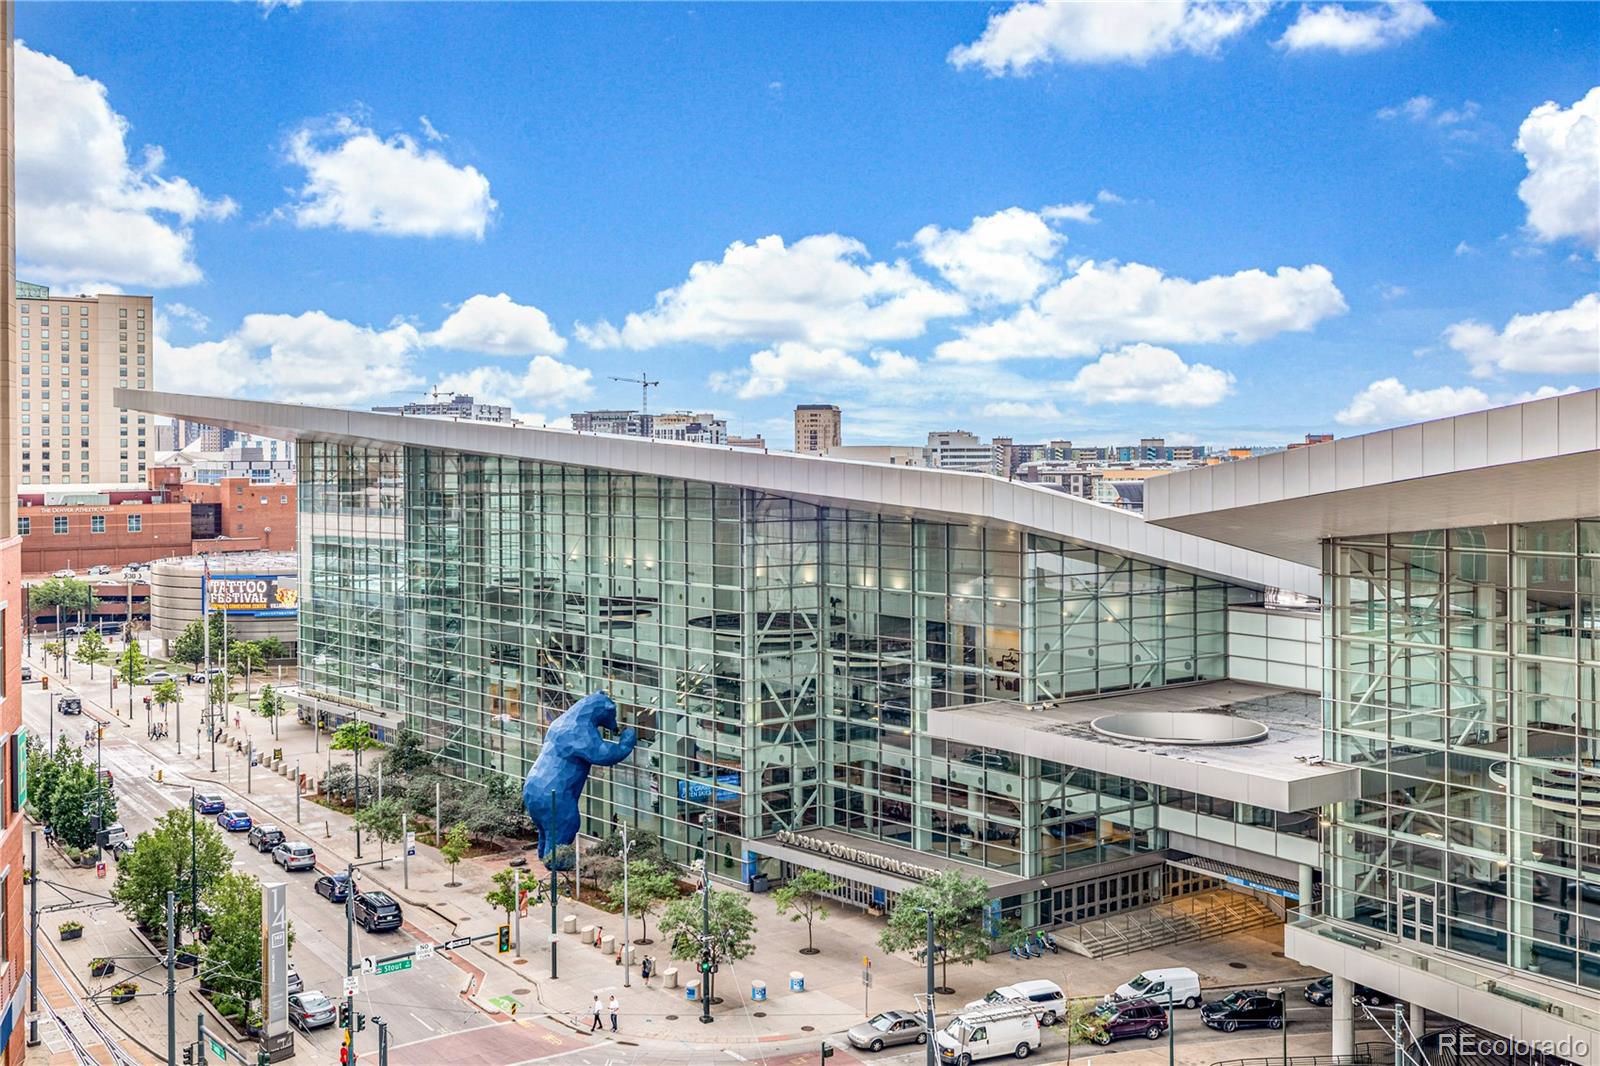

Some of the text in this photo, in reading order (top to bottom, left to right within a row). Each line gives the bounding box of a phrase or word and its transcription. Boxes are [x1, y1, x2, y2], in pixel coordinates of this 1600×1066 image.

[209, 580, 267, 593] TATTOO
[210, 592, 267, 604] FESTIVAL
[829, 844, 900, 873] CONVENTION
[271, 889, 287, 930] 14
[420, 943, 430, 951] NO
[384, 963, 402, 973] Stout
